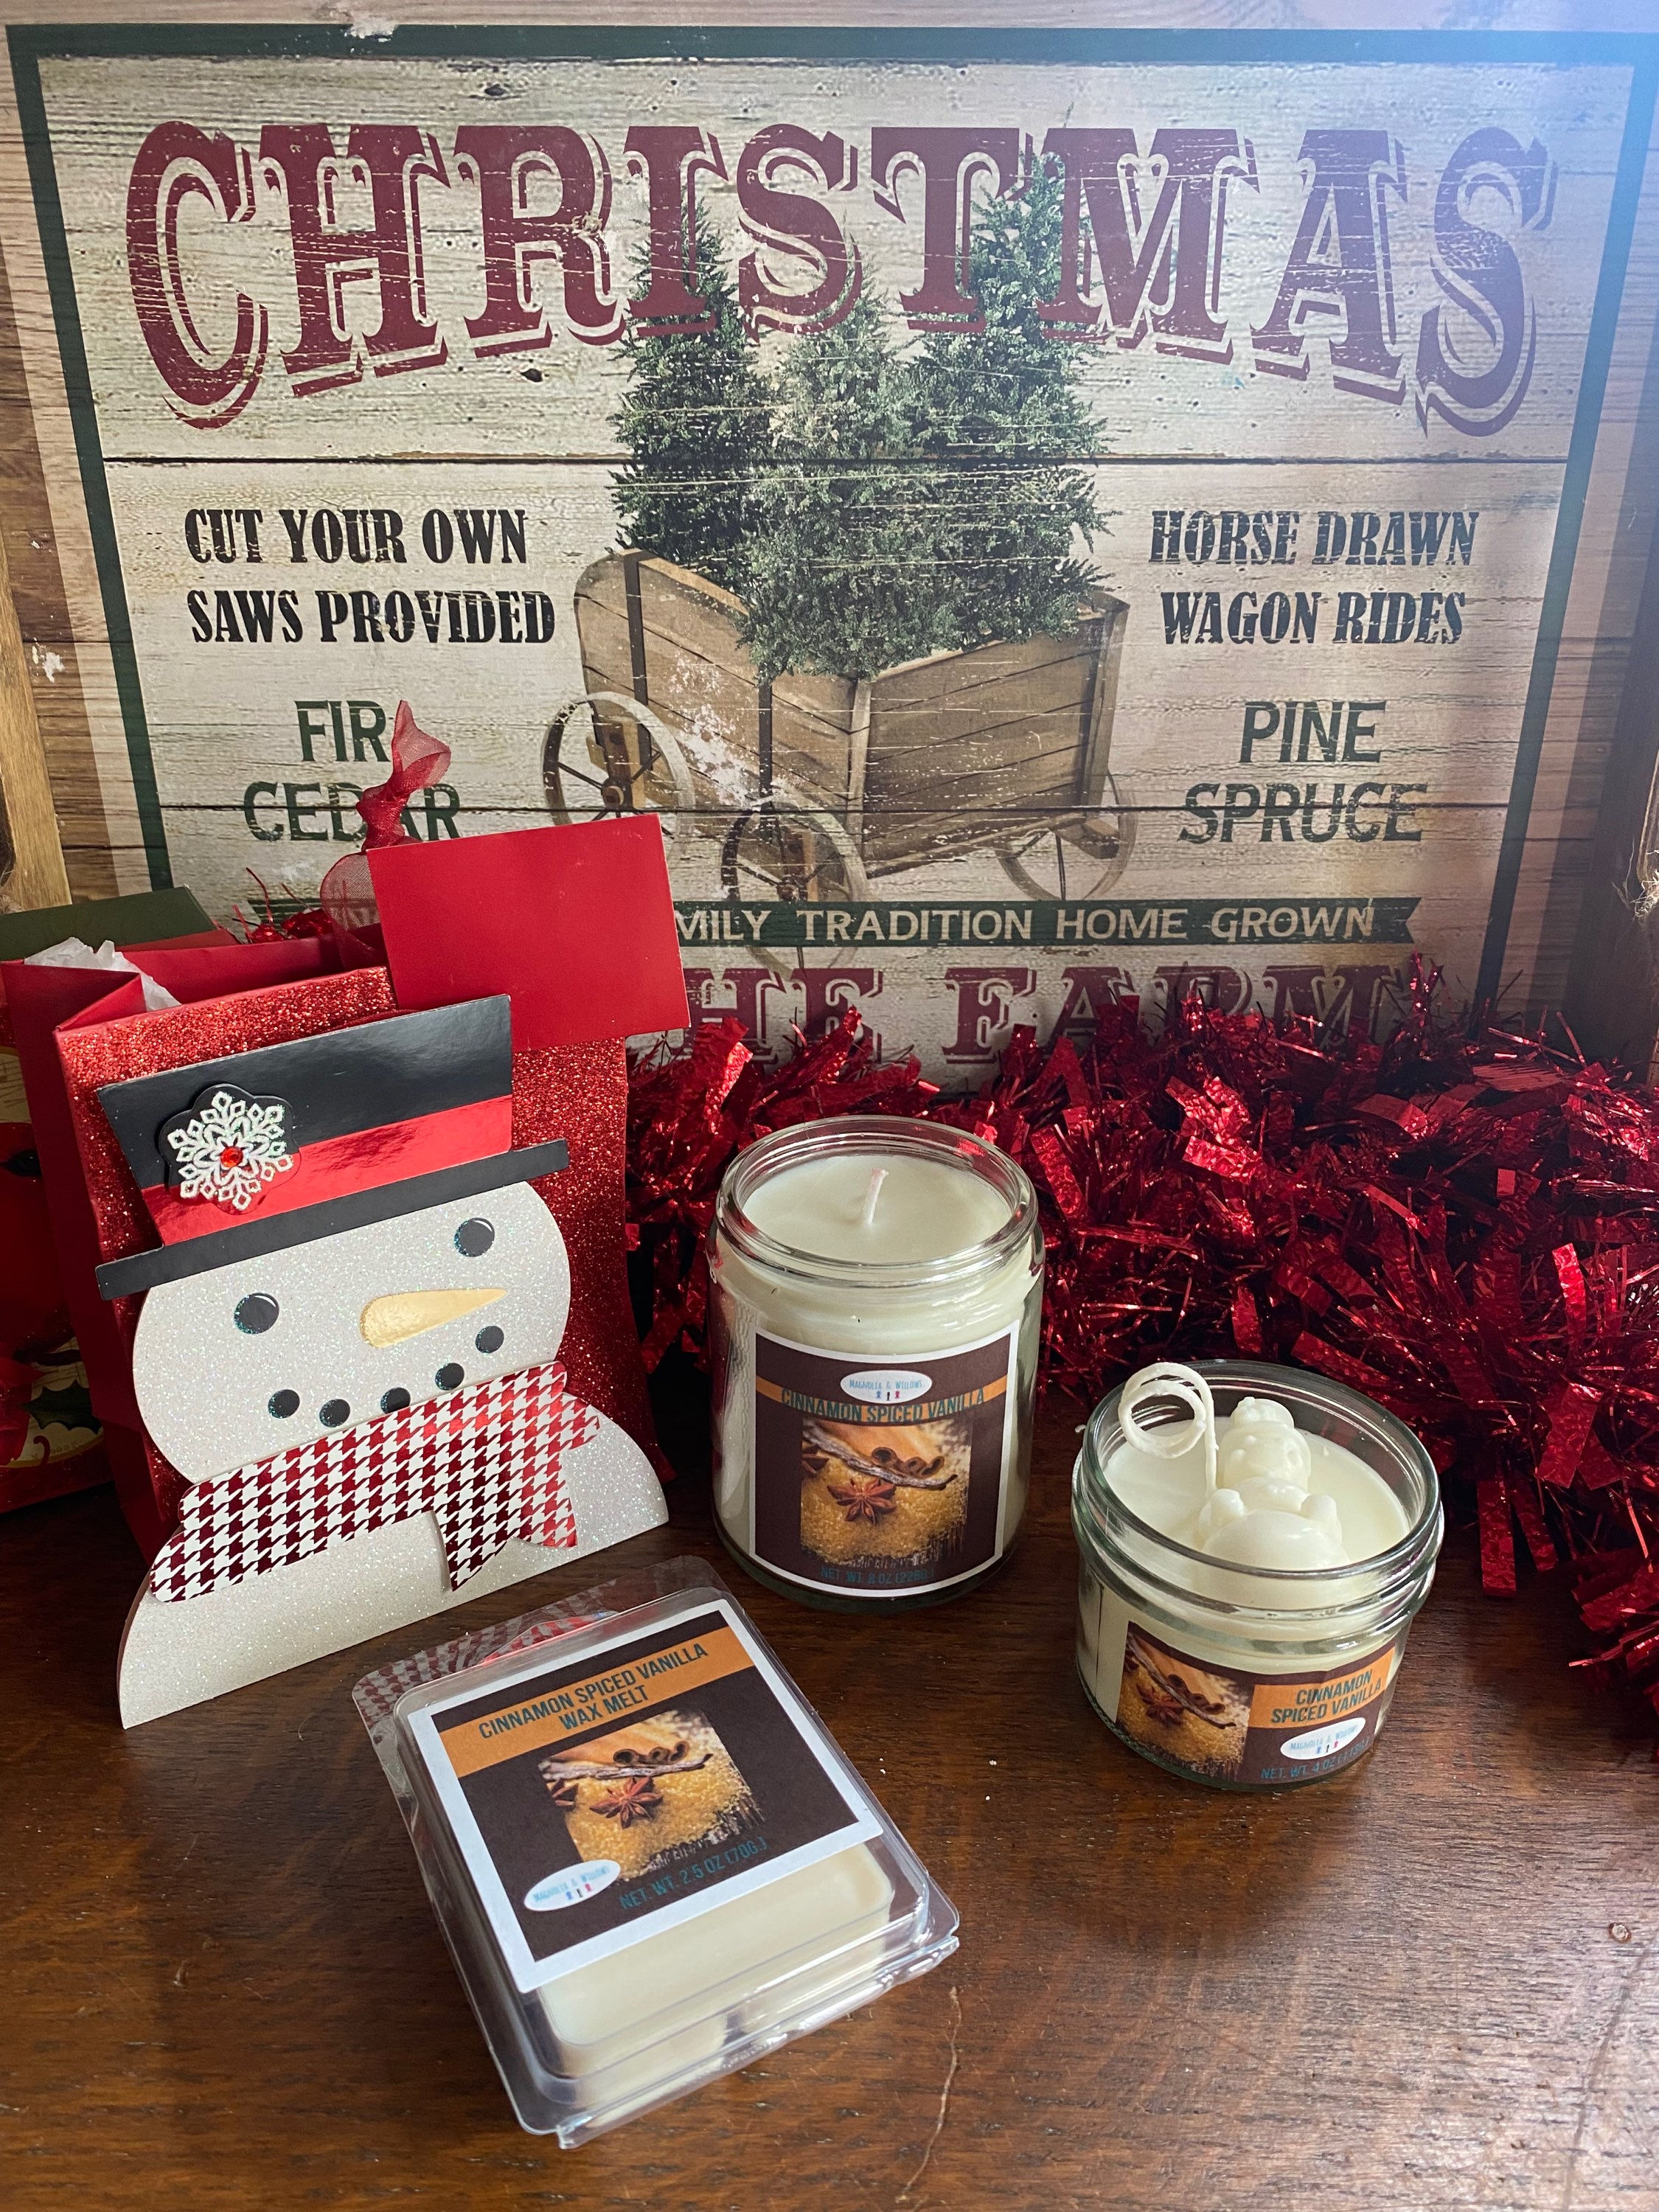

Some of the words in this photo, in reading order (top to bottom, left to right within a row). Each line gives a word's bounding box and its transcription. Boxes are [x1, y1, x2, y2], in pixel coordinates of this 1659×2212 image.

[125, 120, 1558, 437] CHRISTMAS
[184, 509, 262, 563] CUT
[279, 509, 407, 563] YOUR
[422, 509, 527, 564] OWN
[1148, 510, 1300, 565] HORSE
[1312, 510, 1479, 566] DRAWN
[187, 590, 302, 643] SAWS
[316, 590, 555, 643] PROVIDED
[1161, 591, 1321, 644] WAGON
[1332, 591, 1466, 644] RIDES
[294, 700, 389, 762] FIR
[1239, 700, 1386, 762] PINE
[243, 782, 461, 841] CEDR
[1178, 782, 1427, 843] SPRUCE
[675, 909, 772, 941] MILY
[796, 909, 1032, 941] TRADITION
[1056, 908, 1188, 940] HOME
[1211, 906, 1375, 942] GROWN
[781, 1388, 862, 1422] CINNAMON
[866, 1405, 922, 1423] SPICED
[928, 1388, 984, 1419] VANILLA
[849, 1379, 882, 1390] MAGNOLIA
[479, 1692, 575, 1739] CINNAMON
[574, 1669, 636, 1703] SPICED
[636, 1643, 709, 1679] VANILLA
[558, 1703, 603, 1730] WAX
[603, 1685, 649, 1714] MELT
[1271, 1703, 1326, 1723] SPICED
[1332, 1677, 1381, 1715] VANILLA
[1296, 1669, 1373, 1705] CINNAMON
